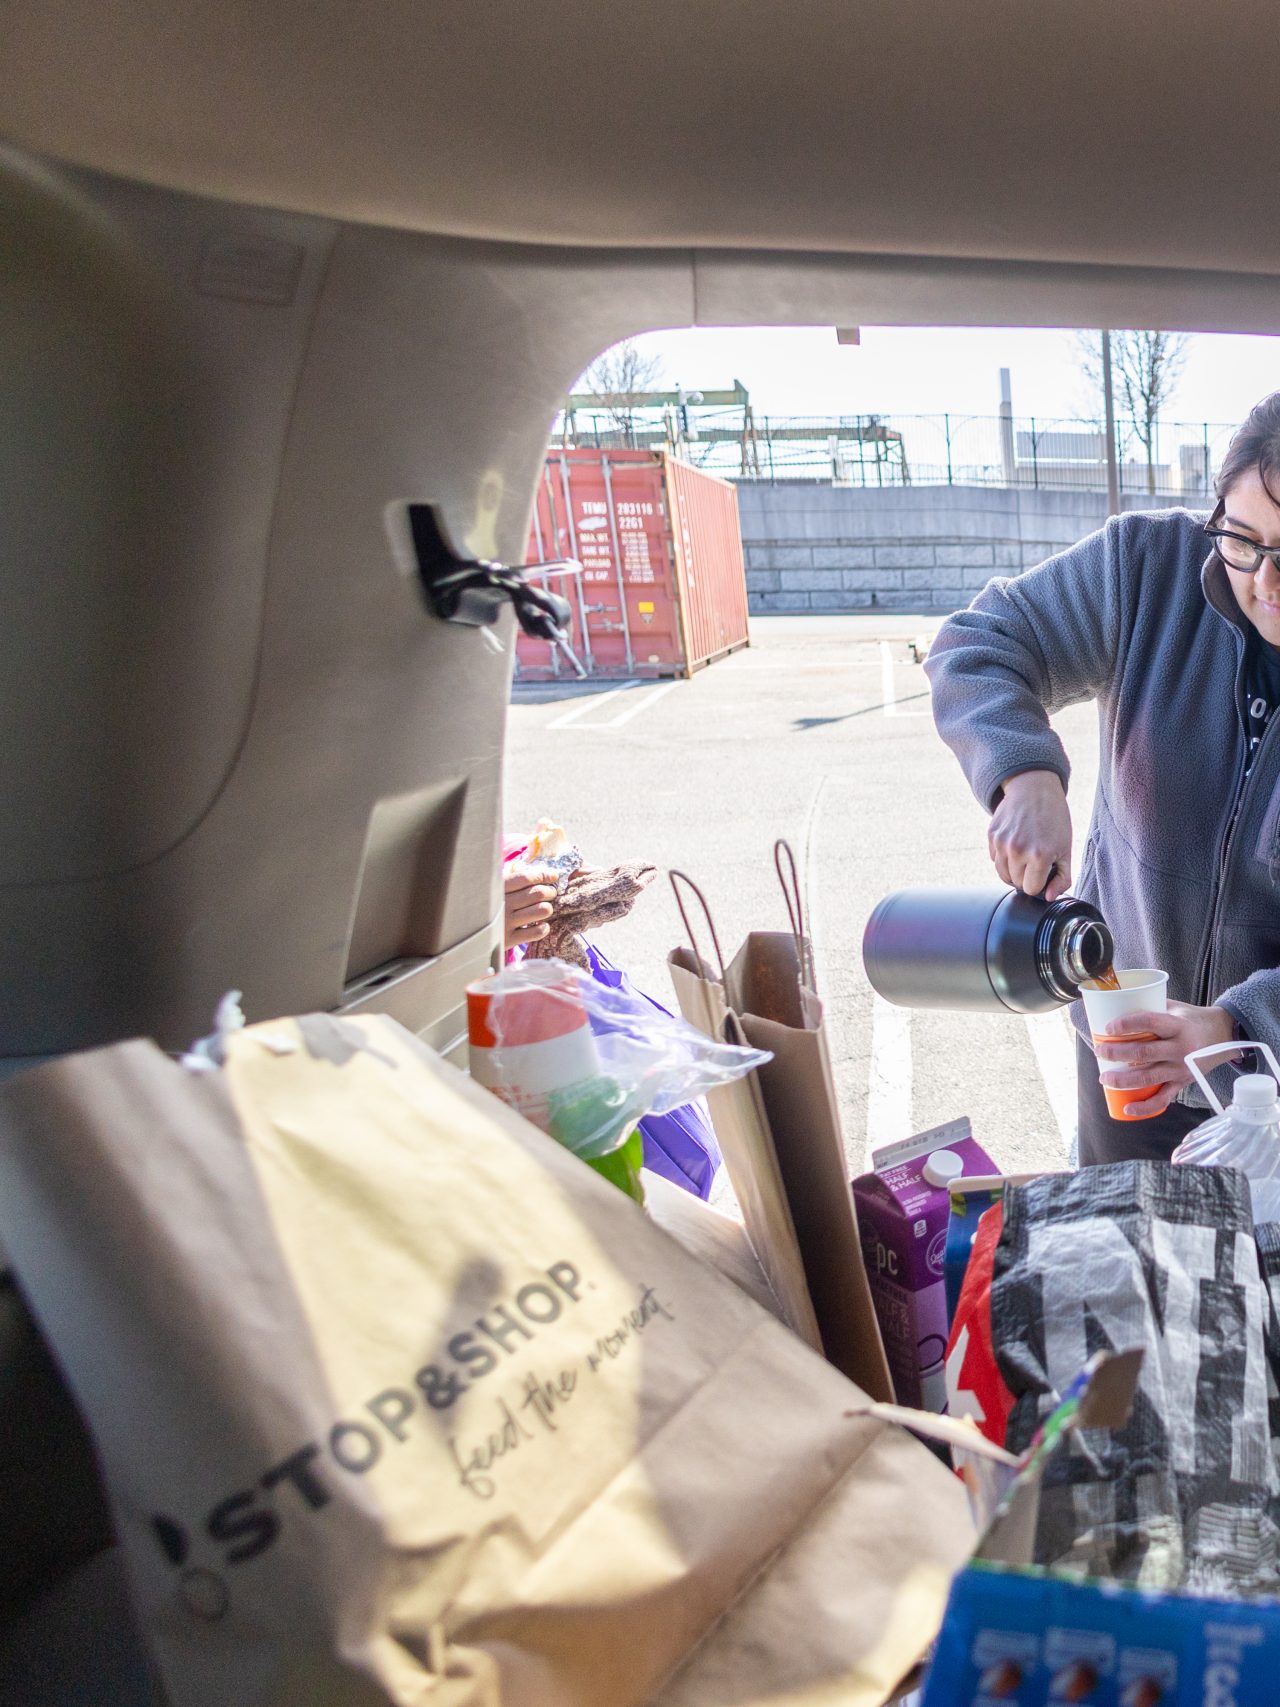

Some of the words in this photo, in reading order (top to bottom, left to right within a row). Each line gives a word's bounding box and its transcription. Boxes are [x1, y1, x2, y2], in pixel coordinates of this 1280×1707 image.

[886, 1174, 909, 1186] HALF
[898, 1175, 923, 1190] HALF
[521, 1370, 577, 1432] the
